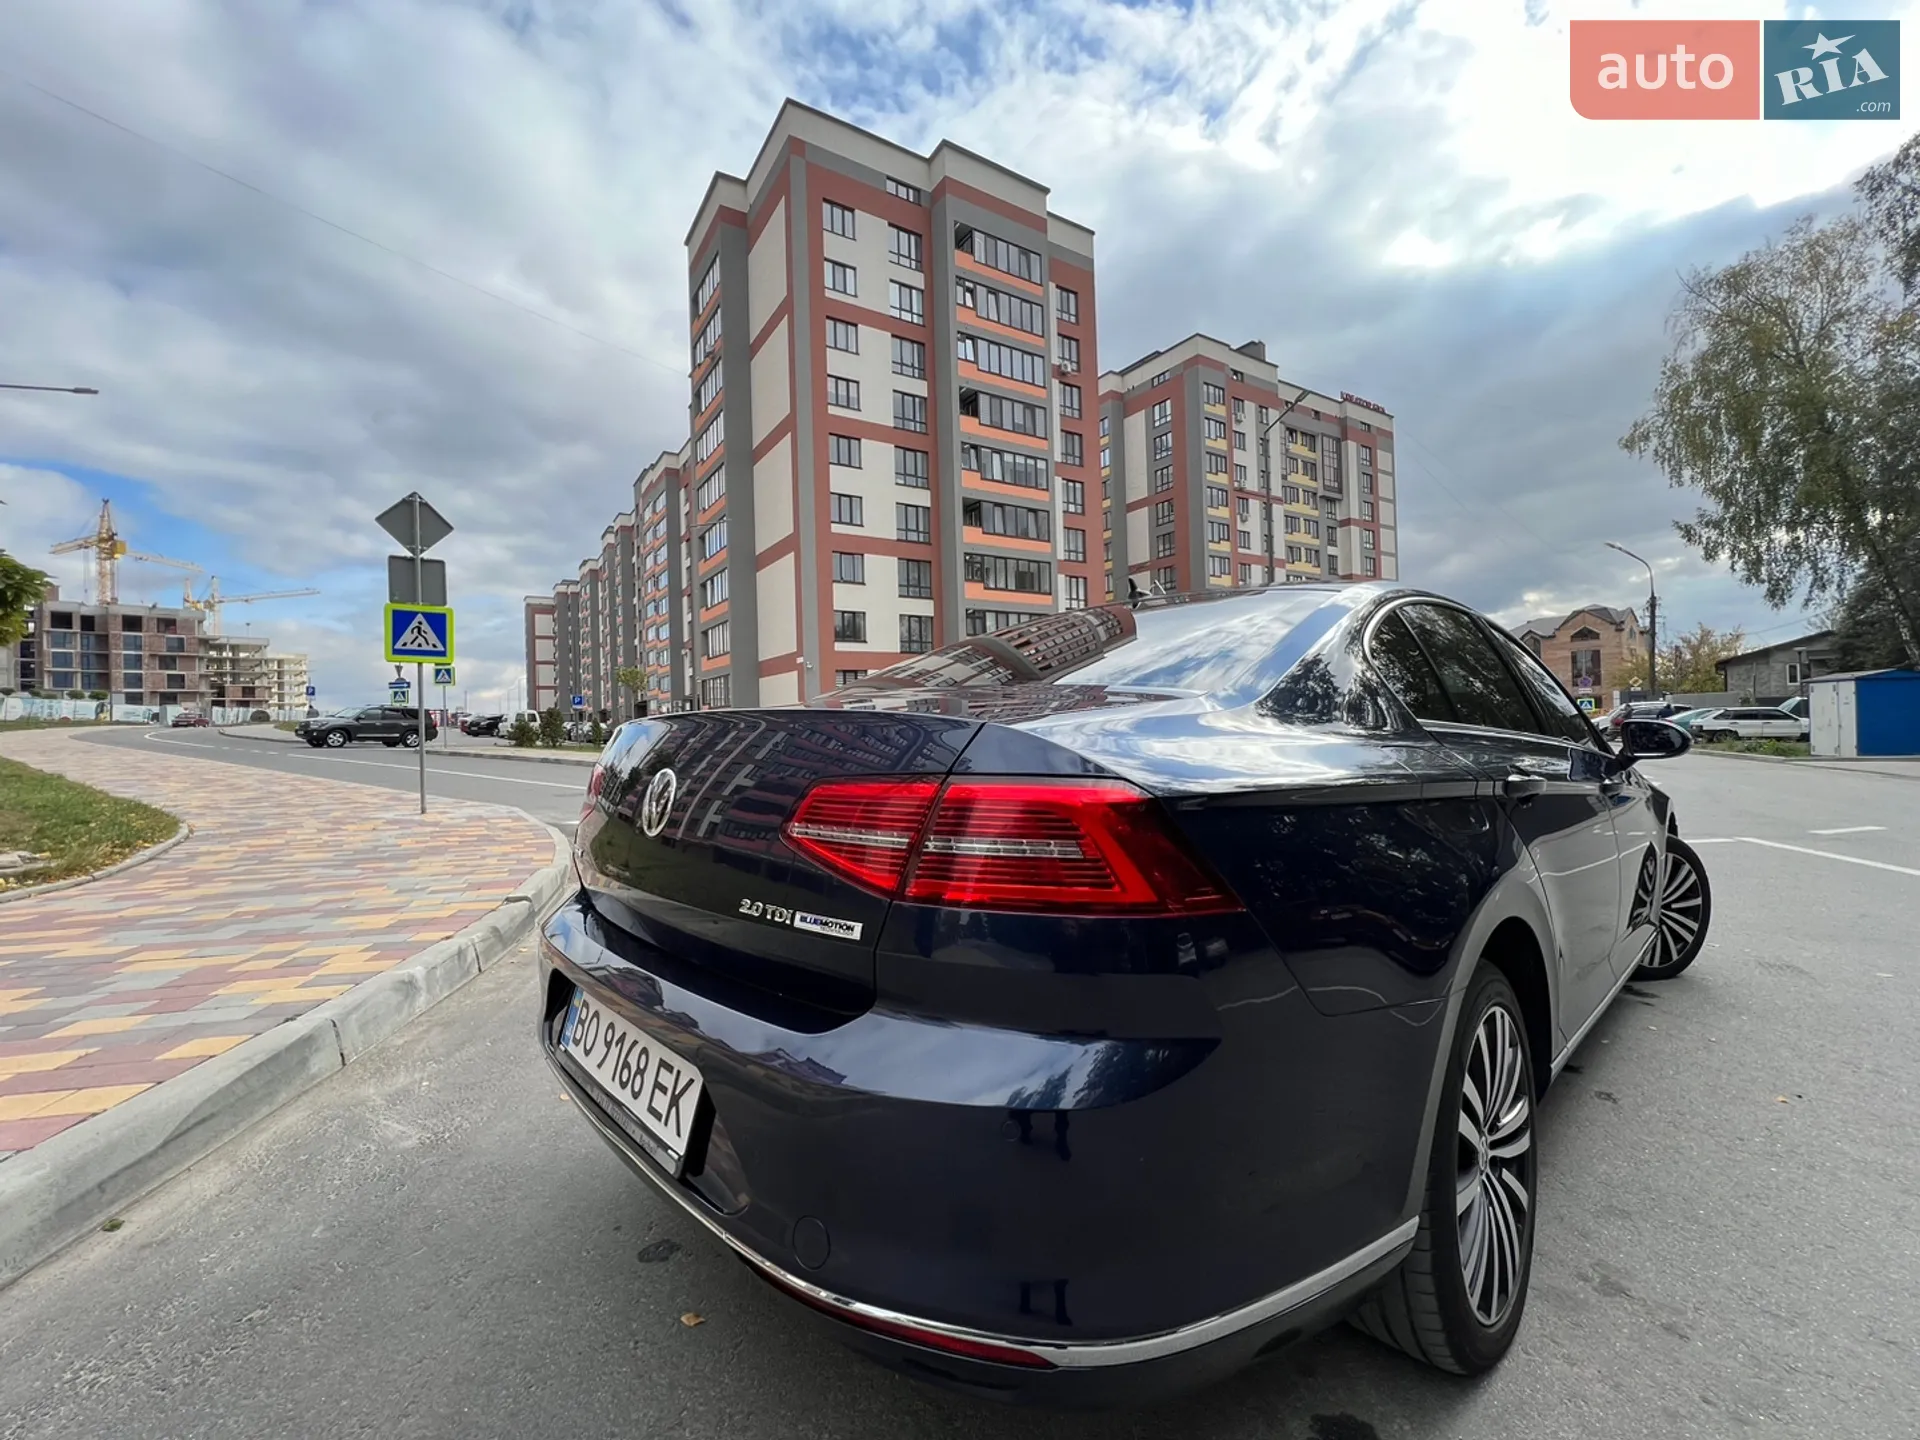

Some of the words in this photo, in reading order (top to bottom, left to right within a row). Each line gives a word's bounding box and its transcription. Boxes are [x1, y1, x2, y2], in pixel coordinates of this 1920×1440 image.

[765, 904, 794, 925] TDI
[799, 914, 855, 933] BLUEMOTION
[597, 1021, 649, 1100] 9168
